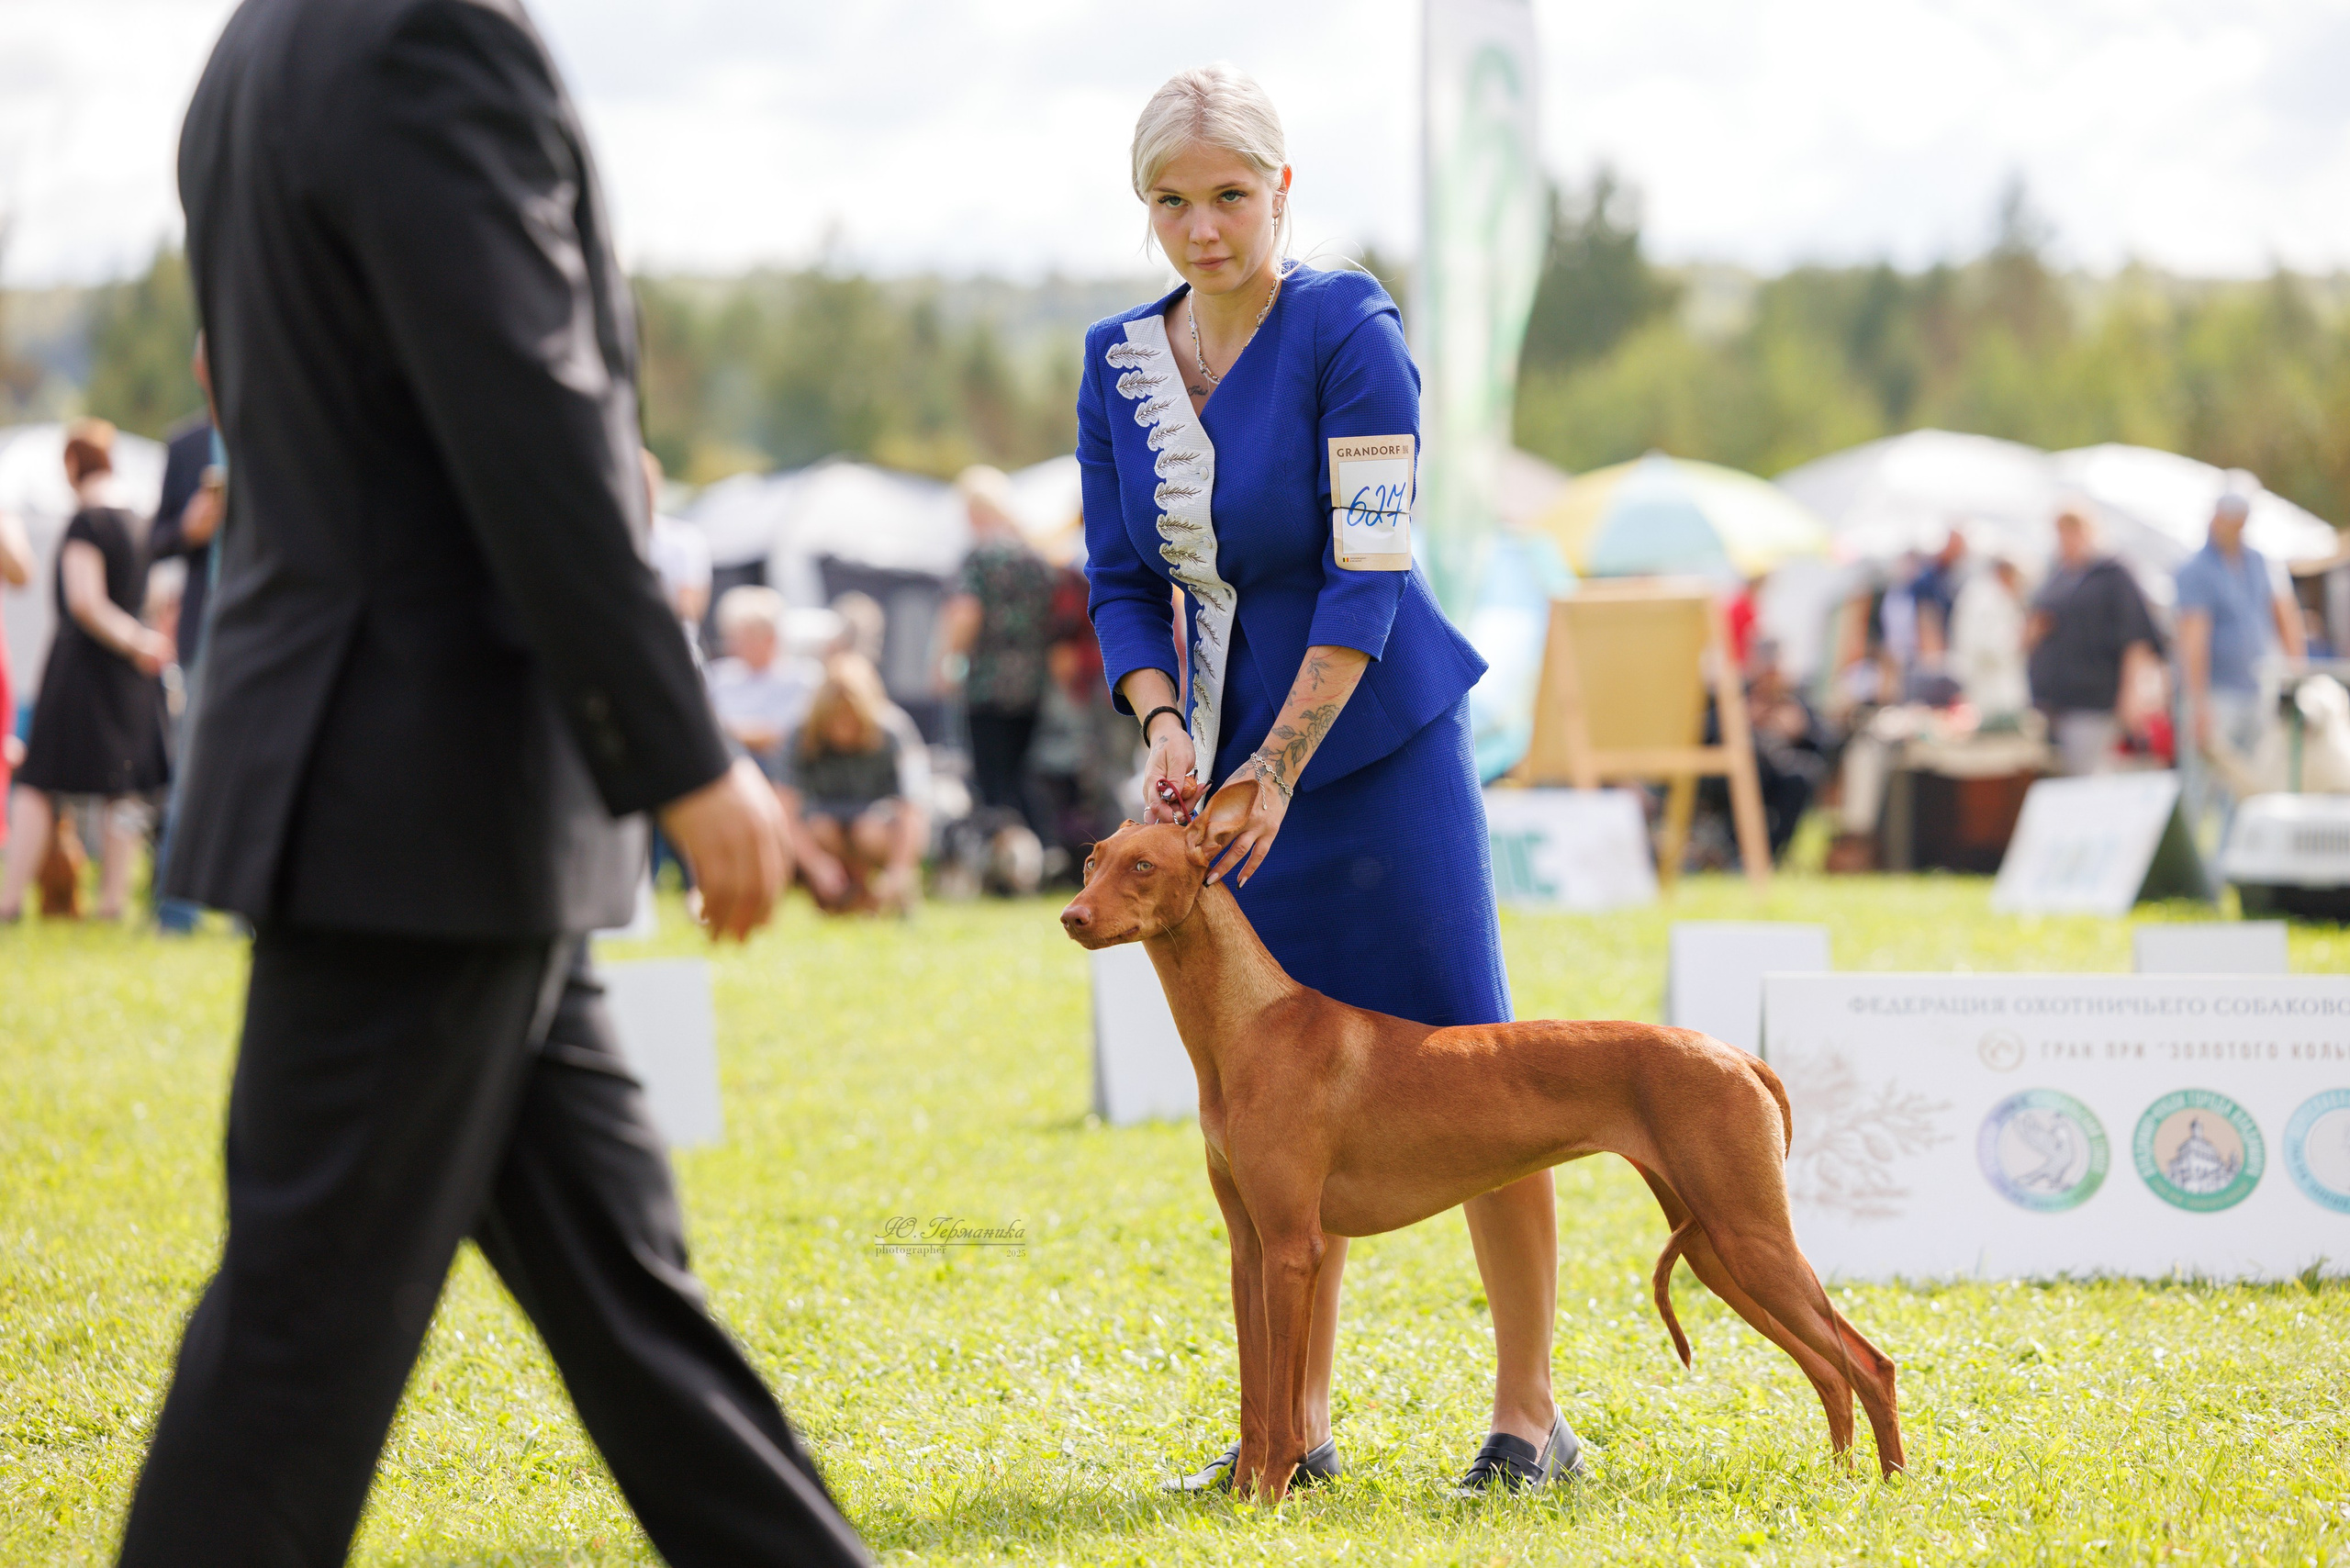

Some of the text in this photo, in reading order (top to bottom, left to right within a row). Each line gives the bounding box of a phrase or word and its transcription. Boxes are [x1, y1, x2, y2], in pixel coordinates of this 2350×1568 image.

[1337, 445, 1401, 457] GRANDORF
[1347, 482, 1406, 527] 627
[1848, 995, 2007, 1015] ФЕДЕРАЦИЯ
[2013, 995, 2207, 1016] ОХОТНИЧЬЕГО
[2291, 1040, 2350, 1060] КОЛЬ
